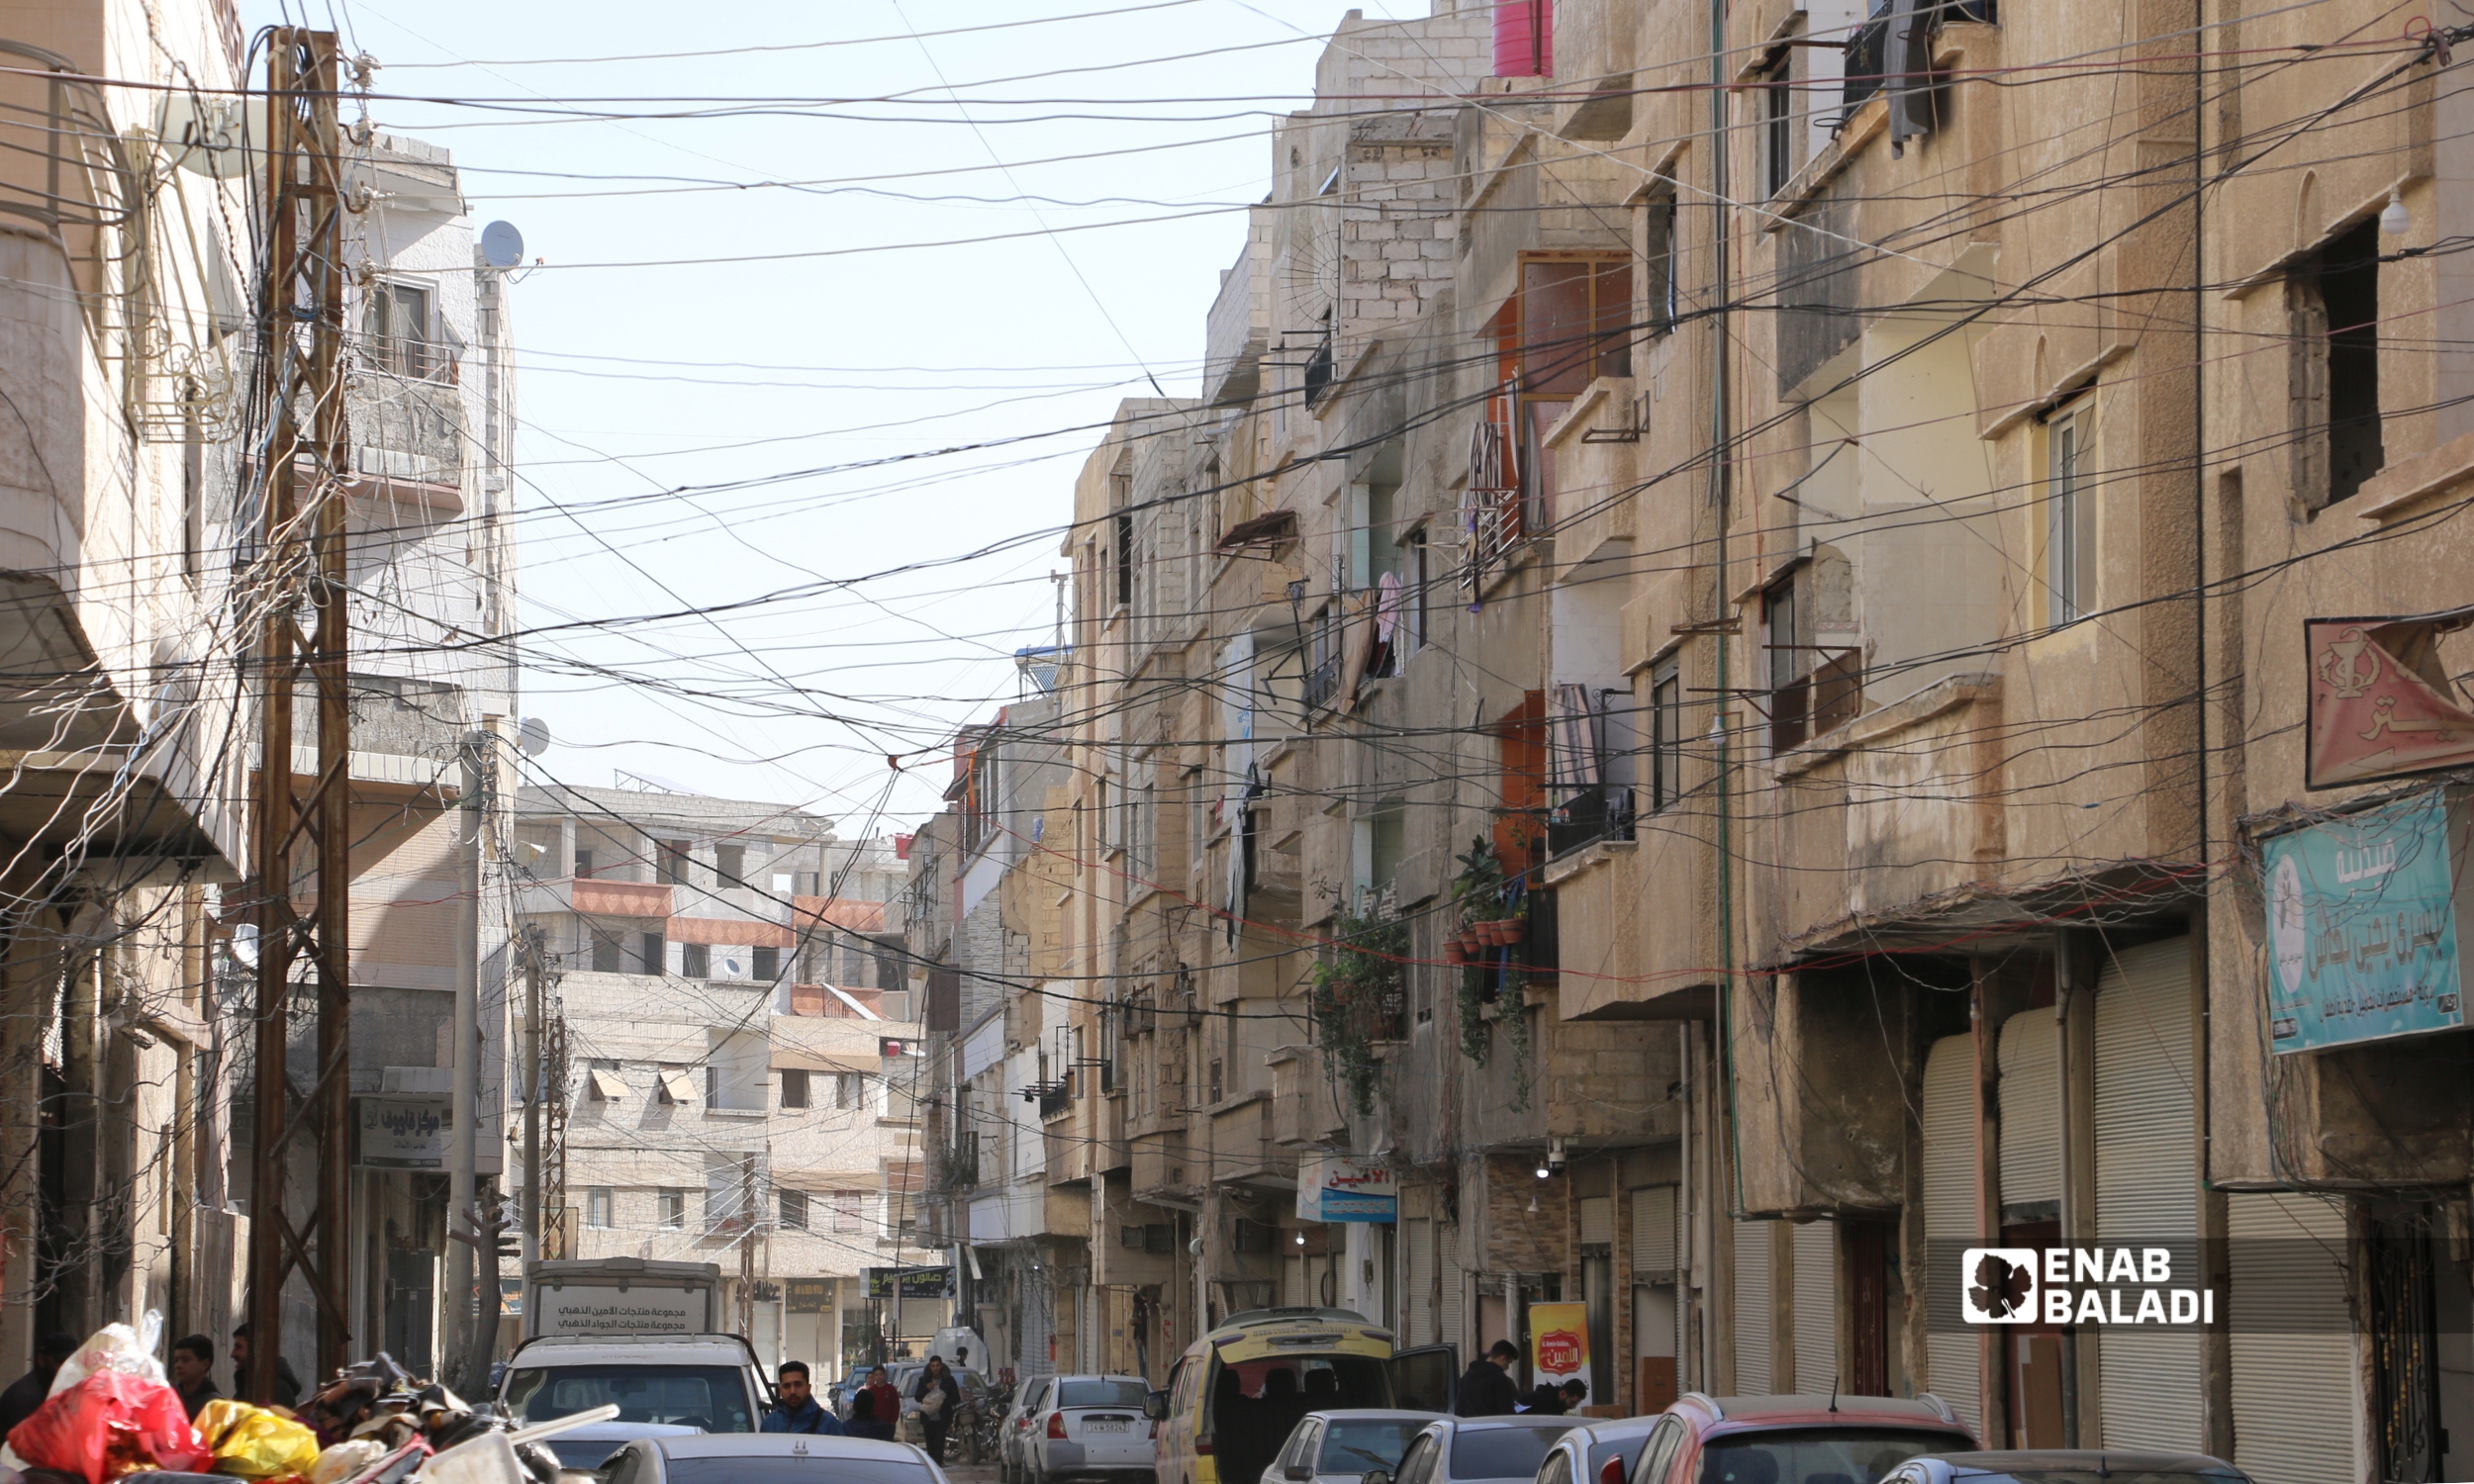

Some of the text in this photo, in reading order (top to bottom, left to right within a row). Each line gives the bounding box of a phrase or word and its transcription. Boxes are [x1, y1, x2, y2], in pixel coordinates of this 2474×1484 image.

[2336, 830, 2397, 895] صيدلية
[416, 1109, 439, 1137] مركز
[912, 1272, 942, 1284] صالون
[558, 1306, 686, 1318] مجموعة منتجات الأمين الذهبي
[558, 1319, 685, 1331] مجموعة منتجات الجواد الذهبي
